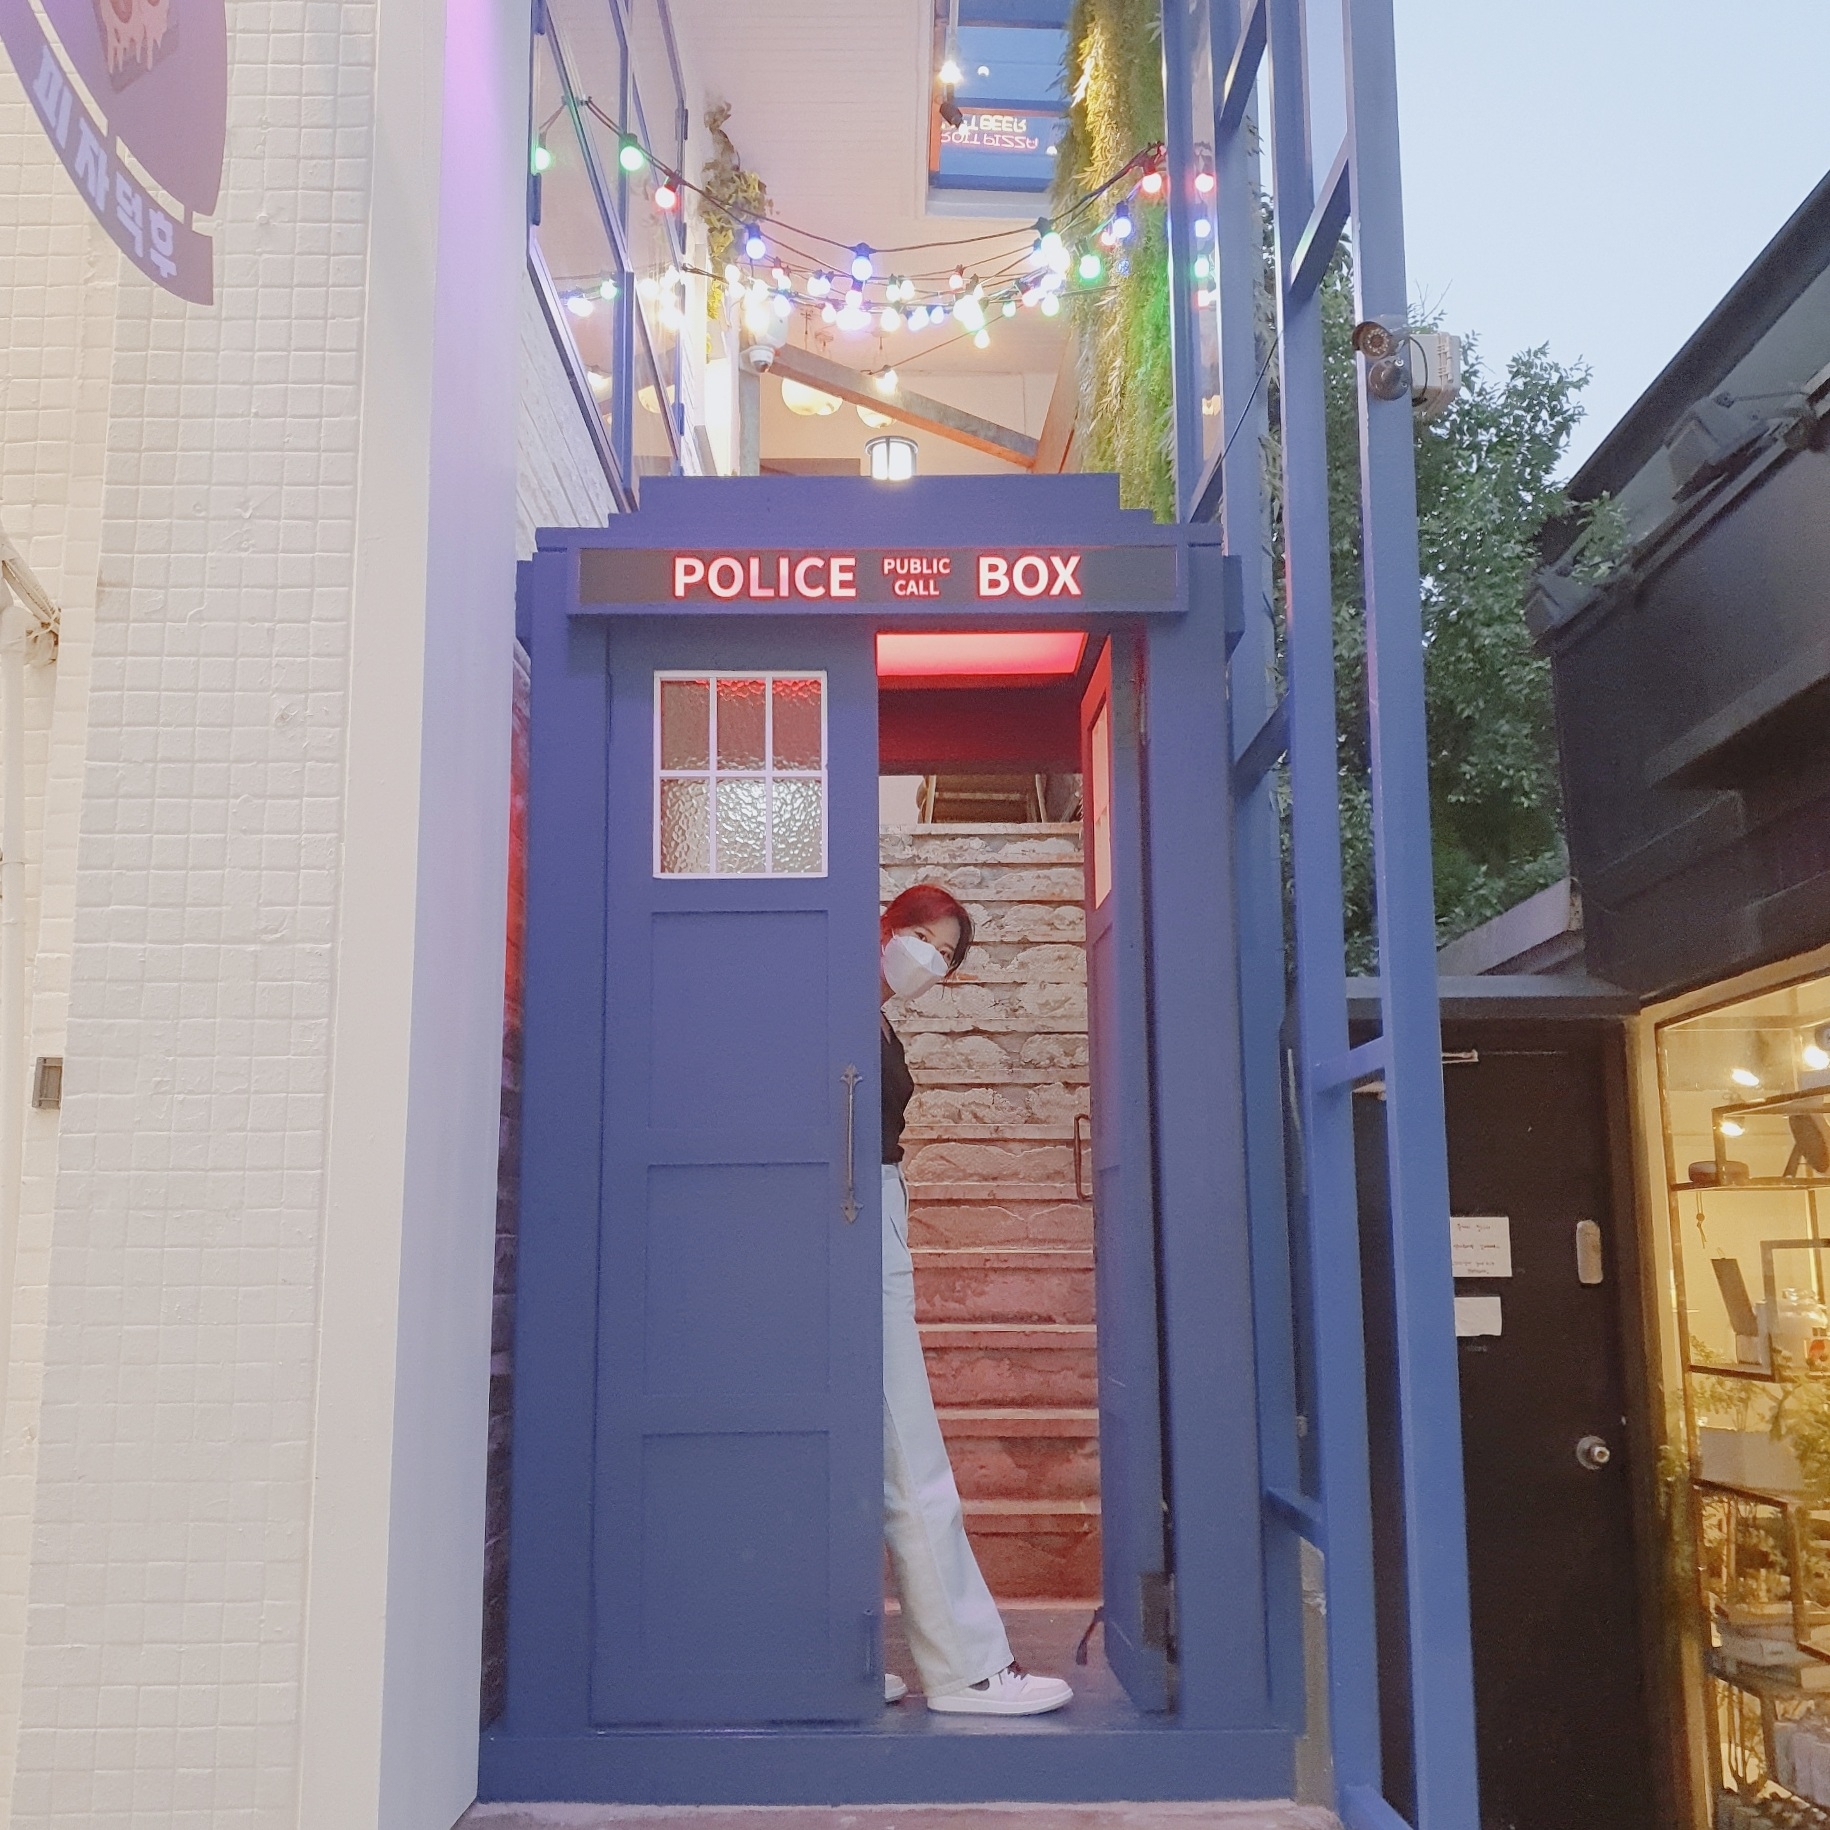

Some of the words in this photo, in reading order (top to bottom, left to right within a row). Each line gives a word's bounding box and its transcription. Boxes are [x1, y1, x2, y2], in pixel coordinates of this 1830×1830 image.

[33, 45, 177, 278] 피자덕후
[674, 556, 857, 598] POLICE
[883, 558, 951, 575] PUBLIC
[894, 578, 940, 596] CALL
[978, 555, 1082, 597] BOX
